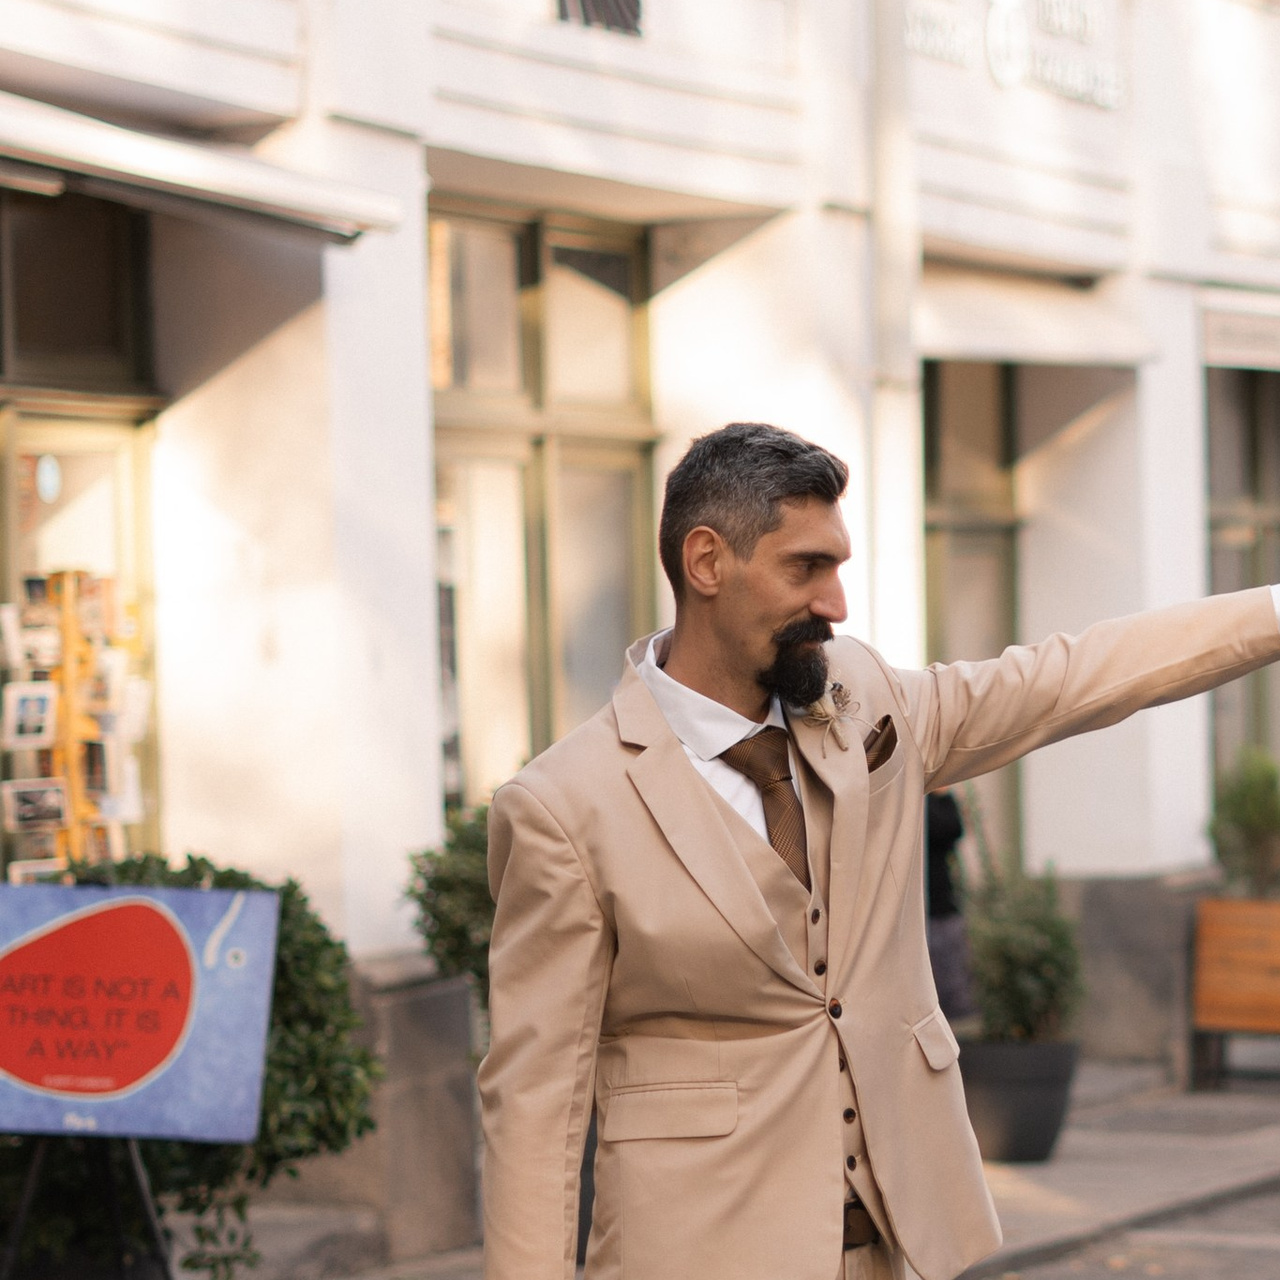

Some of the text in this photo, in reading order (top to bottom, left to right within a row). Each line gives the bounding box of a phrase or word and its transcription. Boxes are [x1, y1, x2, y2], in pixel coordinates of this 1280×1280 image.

[62, 974, 87, 1000] IS
[93, 976, 152, 1002] NOT
[161, 979, 182, 1002] A
[104, 1006, 129, 1029] IT
[136, 1008, 161, 1035] IS
[26, 1037, 46, 1058] A
